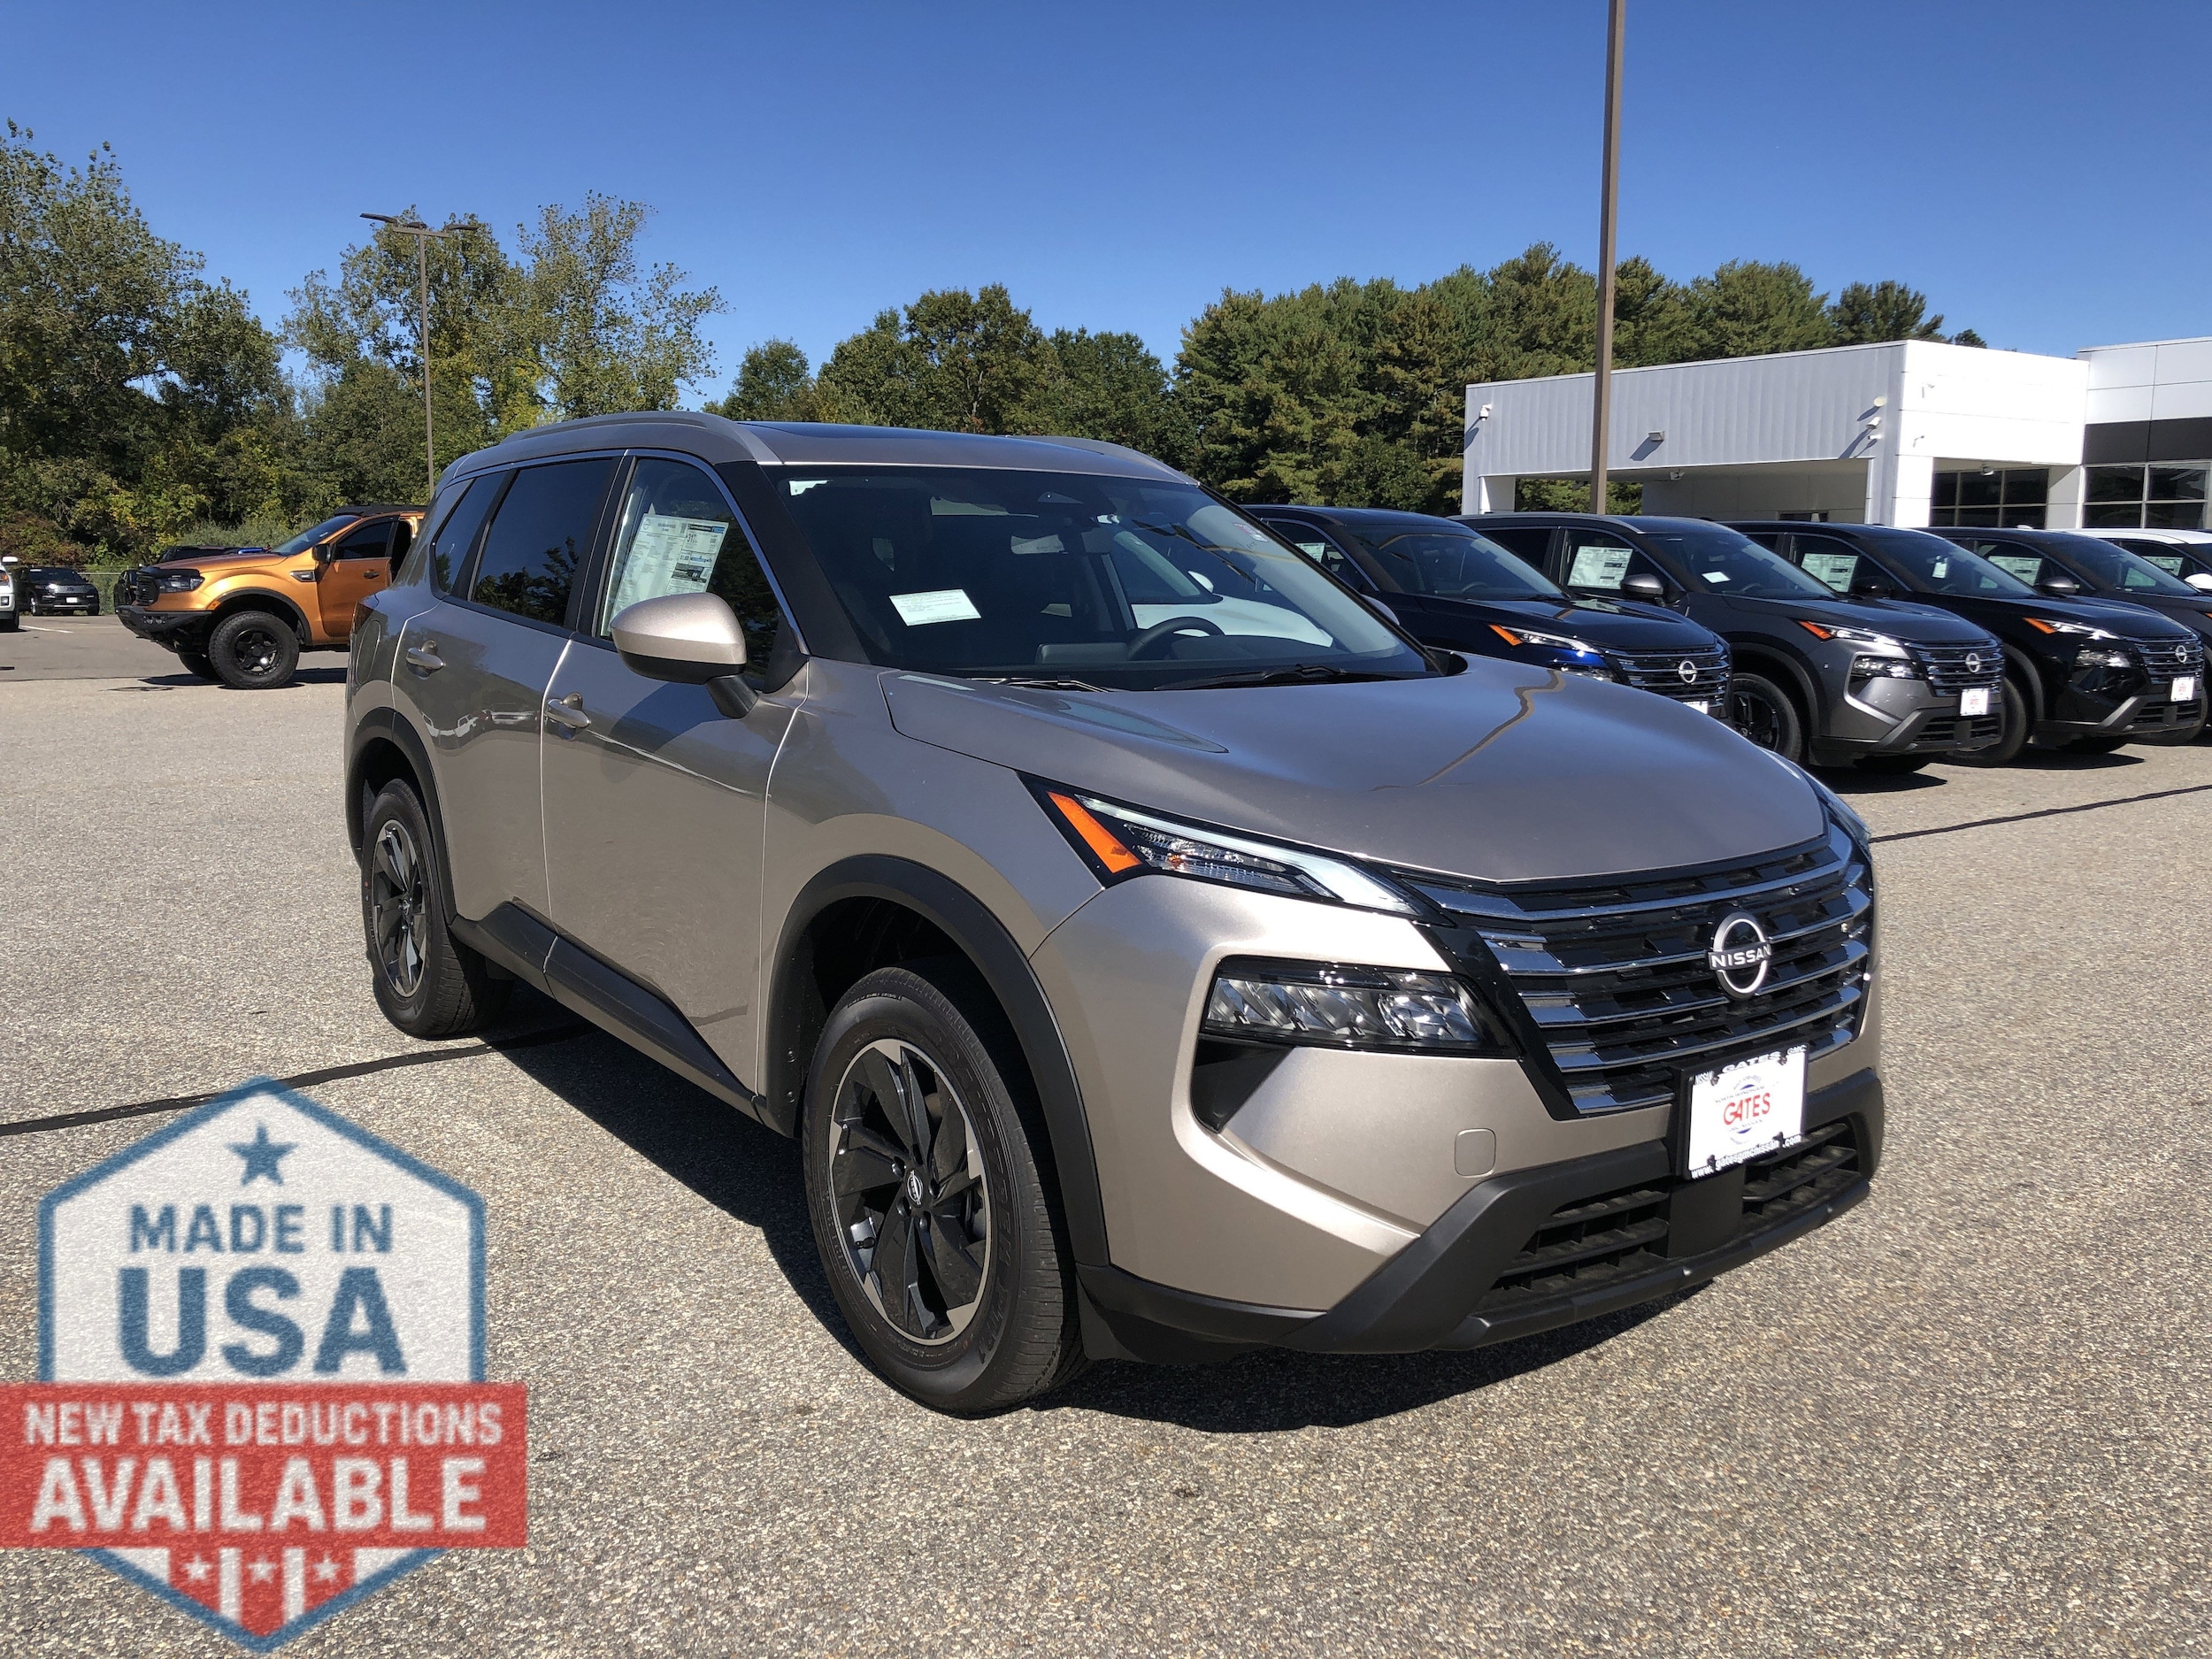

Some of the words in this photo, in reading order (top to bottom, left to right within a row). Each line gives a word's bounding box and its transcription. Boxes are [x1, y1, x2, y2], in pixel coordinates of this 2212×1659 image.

[1710, 943, 1772, 968] NISSAN
[1721, 1050, 1782, 1074] GATES
[1786, 1044, 1808, 1056] GMC
[1723, 1092, 1771, 1125] GATES
